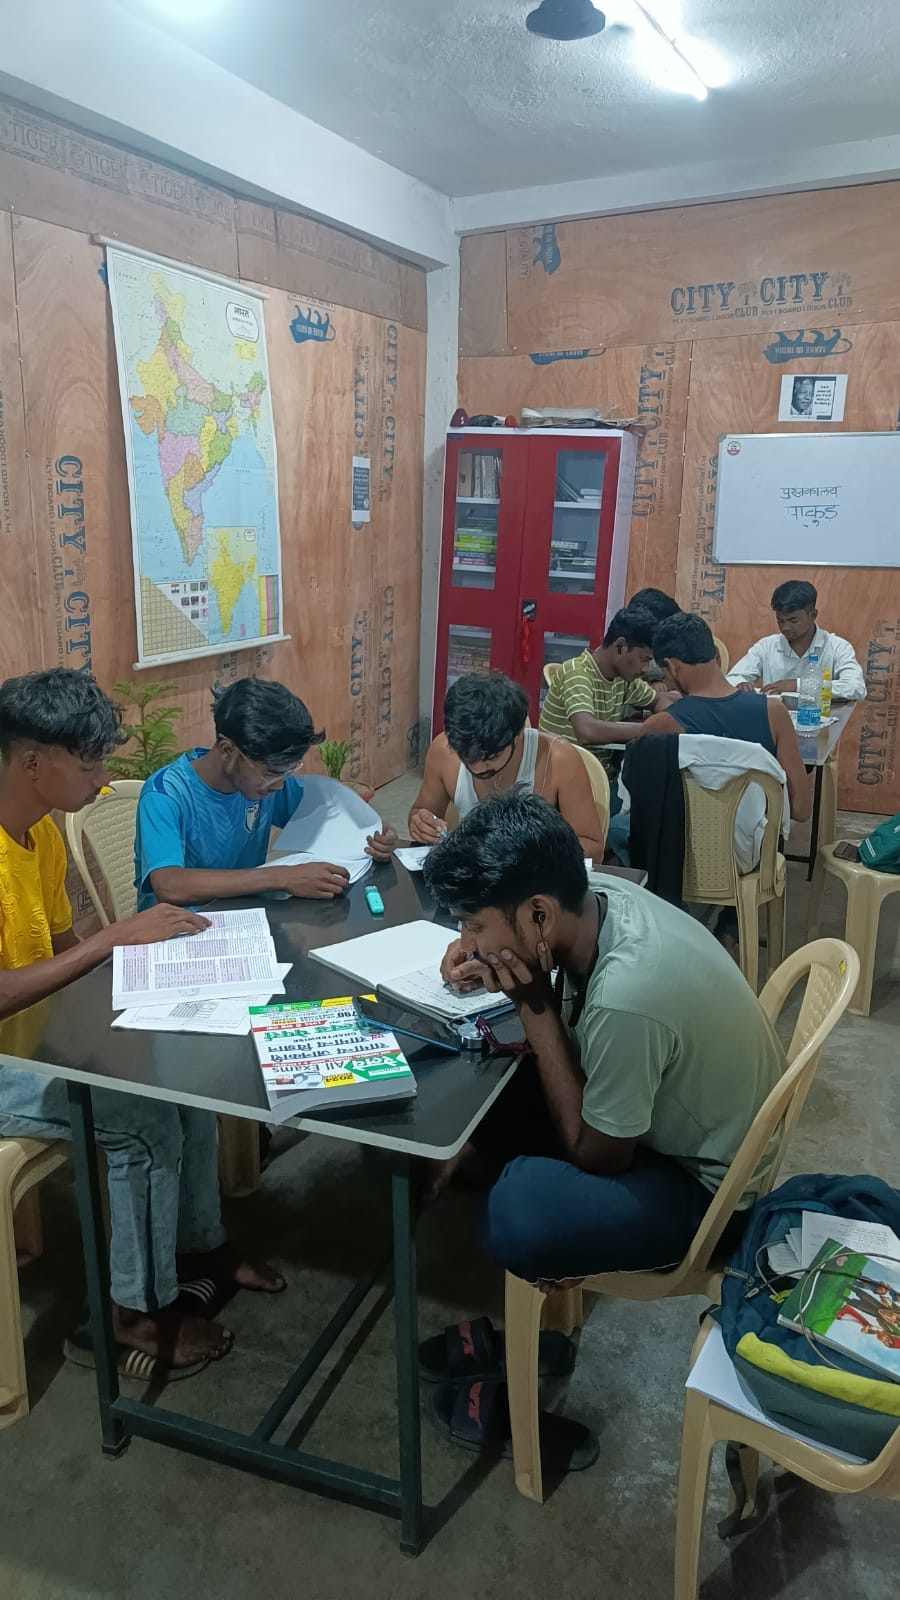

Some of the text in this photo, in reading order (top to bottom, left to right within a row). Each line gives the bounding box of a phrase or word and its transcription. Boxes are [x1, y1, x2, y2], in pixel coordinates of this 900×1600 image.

[8, 120, 60, 157] TIGER
[151, 174, 190, 201] TIGER
[670, 281, 735, 316] CITY
[759, 271, 831, 307] CITY
[735, 306, 758, 318] CLUB
[778, 306, 802, 315] BOARD
[827, 296, 853, 309] CLUB
[664, 342, 676, 366] CLU
[774, 346, 794, 355] INDIA
[804, 345, 826, 354] MAKE
[354, 367, 365, 438] CITY
[384, 324, 398, 482] CITY CITY
[658, 432, 669, 455] CLUB
[2, 470, 10, 506] BOARD
[47, 482, 55, 518] BOARD
[632, 458, 659, 518] CITY
[780, 485, 842, 500] पुस्तकालय
[55, 454, 87, 554] CITY
[50, 526, 58, 554] DOOR
[696, 516, 706, 540] CLUB
[52, 556, 64, 591] CLUB
[382, 586, 394, 723] CITY CITY
[350, 633, 363, 778] CITY CITY
[857, 640, 896, 786] CITY CITY
[888, 704, 897, 726] CLUB
[268, 1042, 312, 1053] विज्ञान
[292, 1032, 357, 1044] CHAPTERWISE
[316, 1035, 369, 1048] सामान्य
[336, 1042, 390, 1055] सामान्य
[270, 1050, 332, 1062] जानकारी
[272, 1061, 344, 1074] All Exams
[351, 1056, 398, 1071] रेलवे
[324, 1074, 354, 1083] 2024
